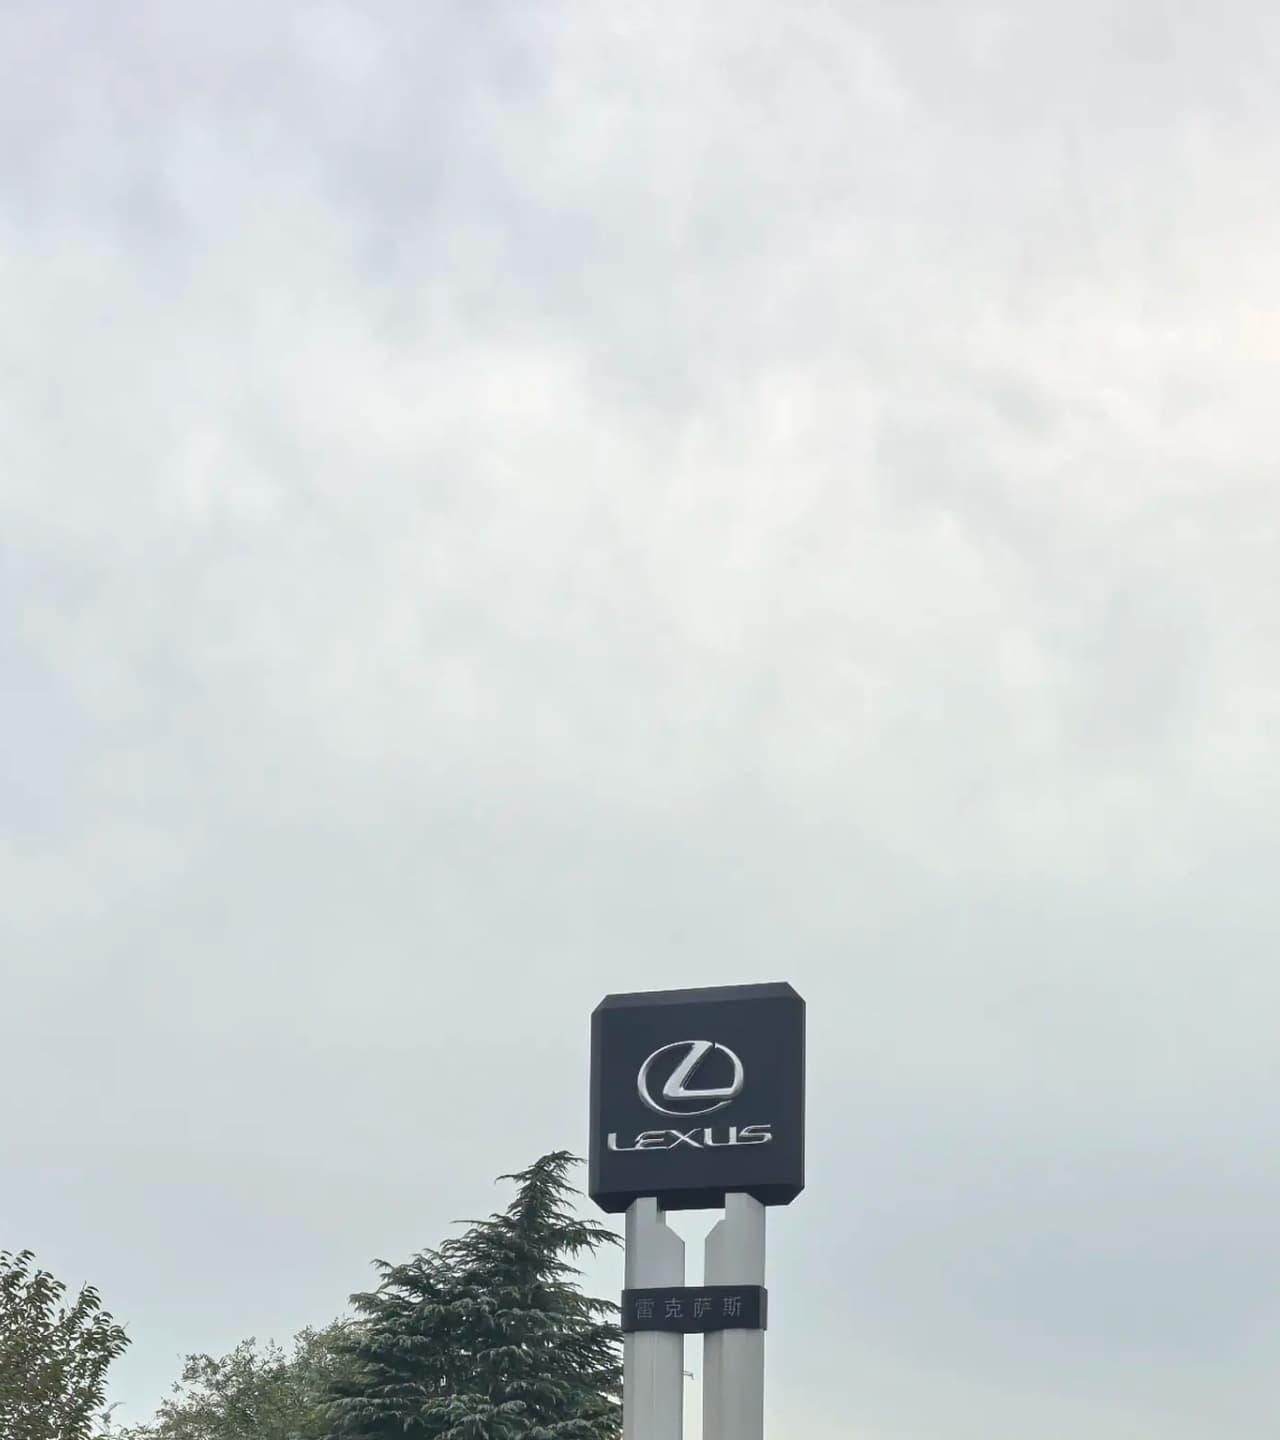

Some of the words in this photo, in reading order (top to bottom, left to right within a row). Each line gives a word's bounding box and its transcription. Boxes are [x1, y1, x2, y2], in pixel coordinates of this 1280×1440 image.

[607, 1124, 772, 1151] LEXUS
[635, 1296, 742, 1320] 雷克萨斯
